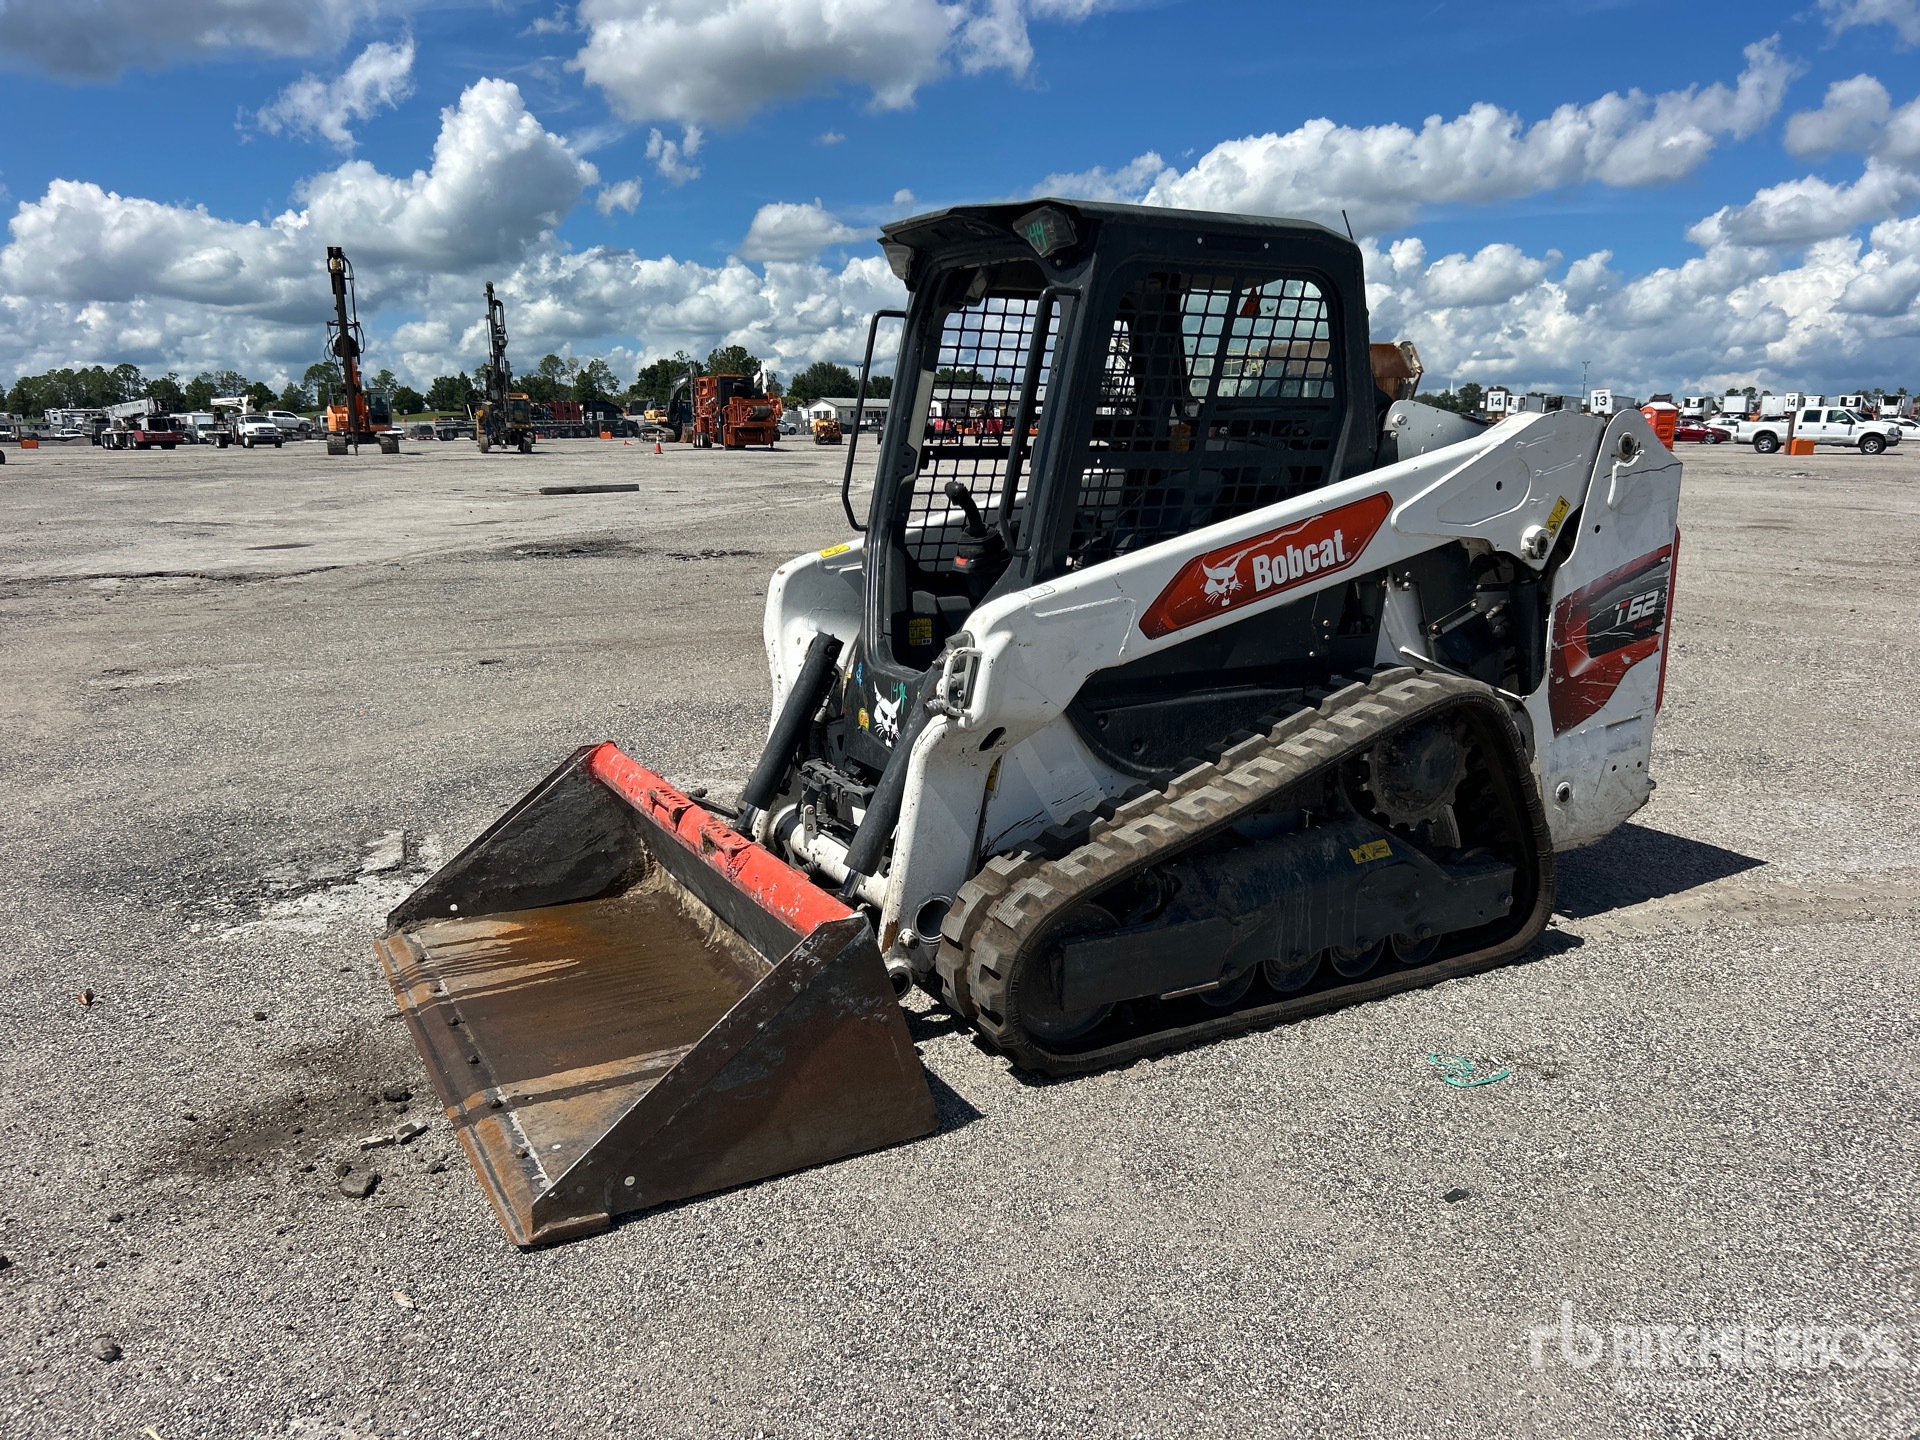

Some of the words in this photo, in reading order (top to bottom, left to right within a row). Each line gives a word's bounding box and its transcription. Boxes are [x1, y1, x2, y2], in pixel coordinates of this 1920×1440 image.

[1490, 397, 1502, 407] 14
[1594, 396, 1608, 407] 13
[1787, 398, 1796, 407] 14
[1252, 529, 1346, 592] Bobcat
[1615, 590, 1659, 626] T62
